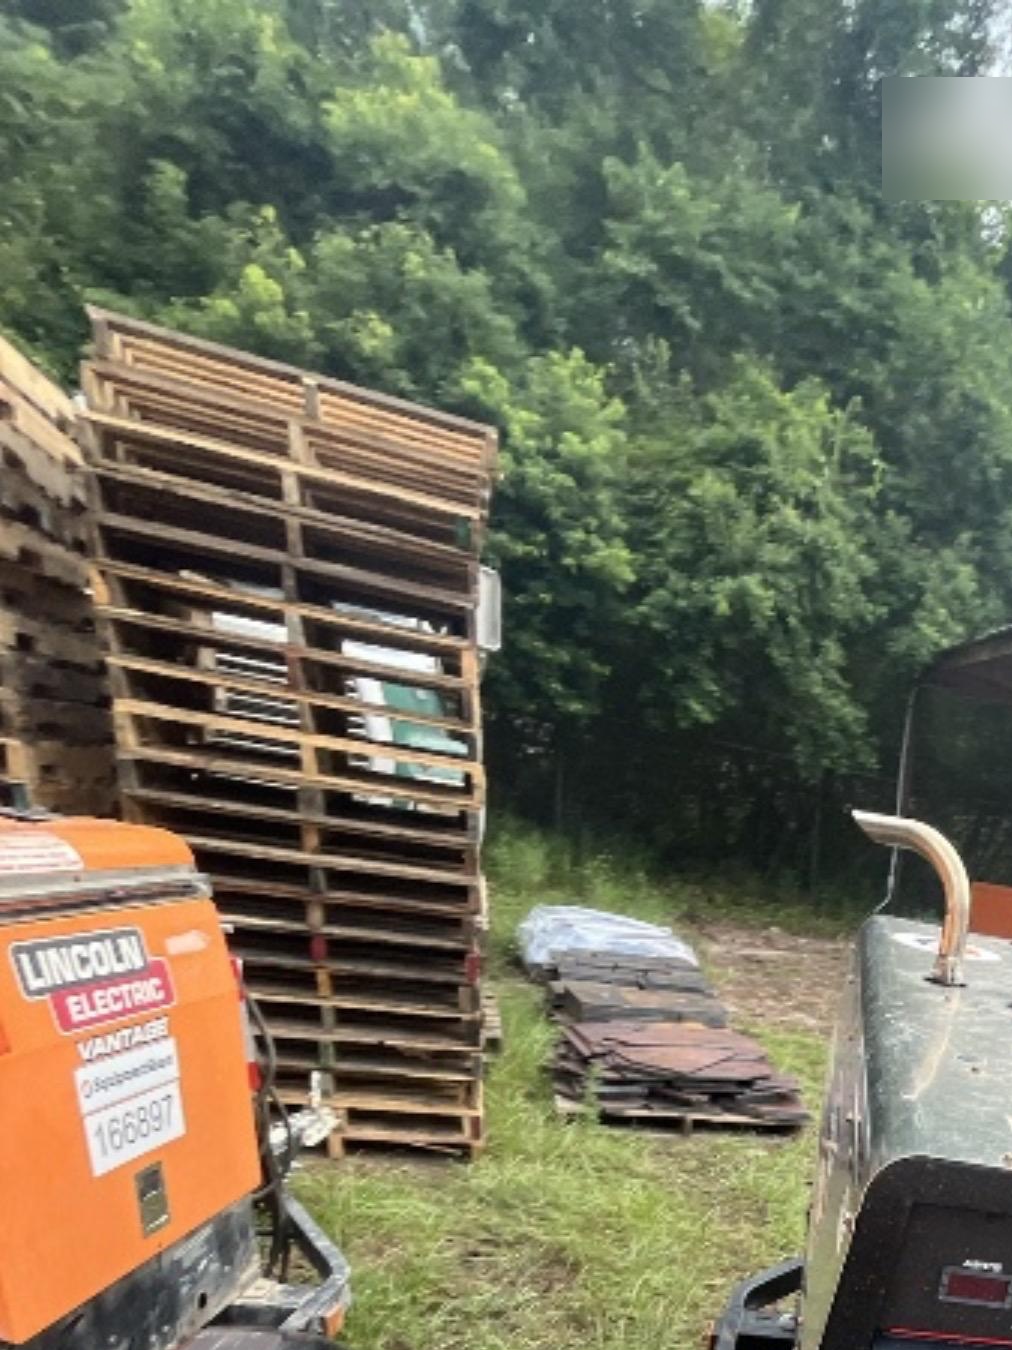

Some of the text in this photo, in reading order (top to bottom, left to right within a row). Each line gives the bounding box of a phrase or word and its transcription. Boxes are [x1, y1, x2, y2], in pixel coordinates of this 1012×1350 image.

[19, 936, 145, 991] LINCOLN
[66, 976, 165, 1024] ELECTRIC
[77, 1016, 169, 1062] VANTAGE
[94, 1094, 172, 1157] 166897
